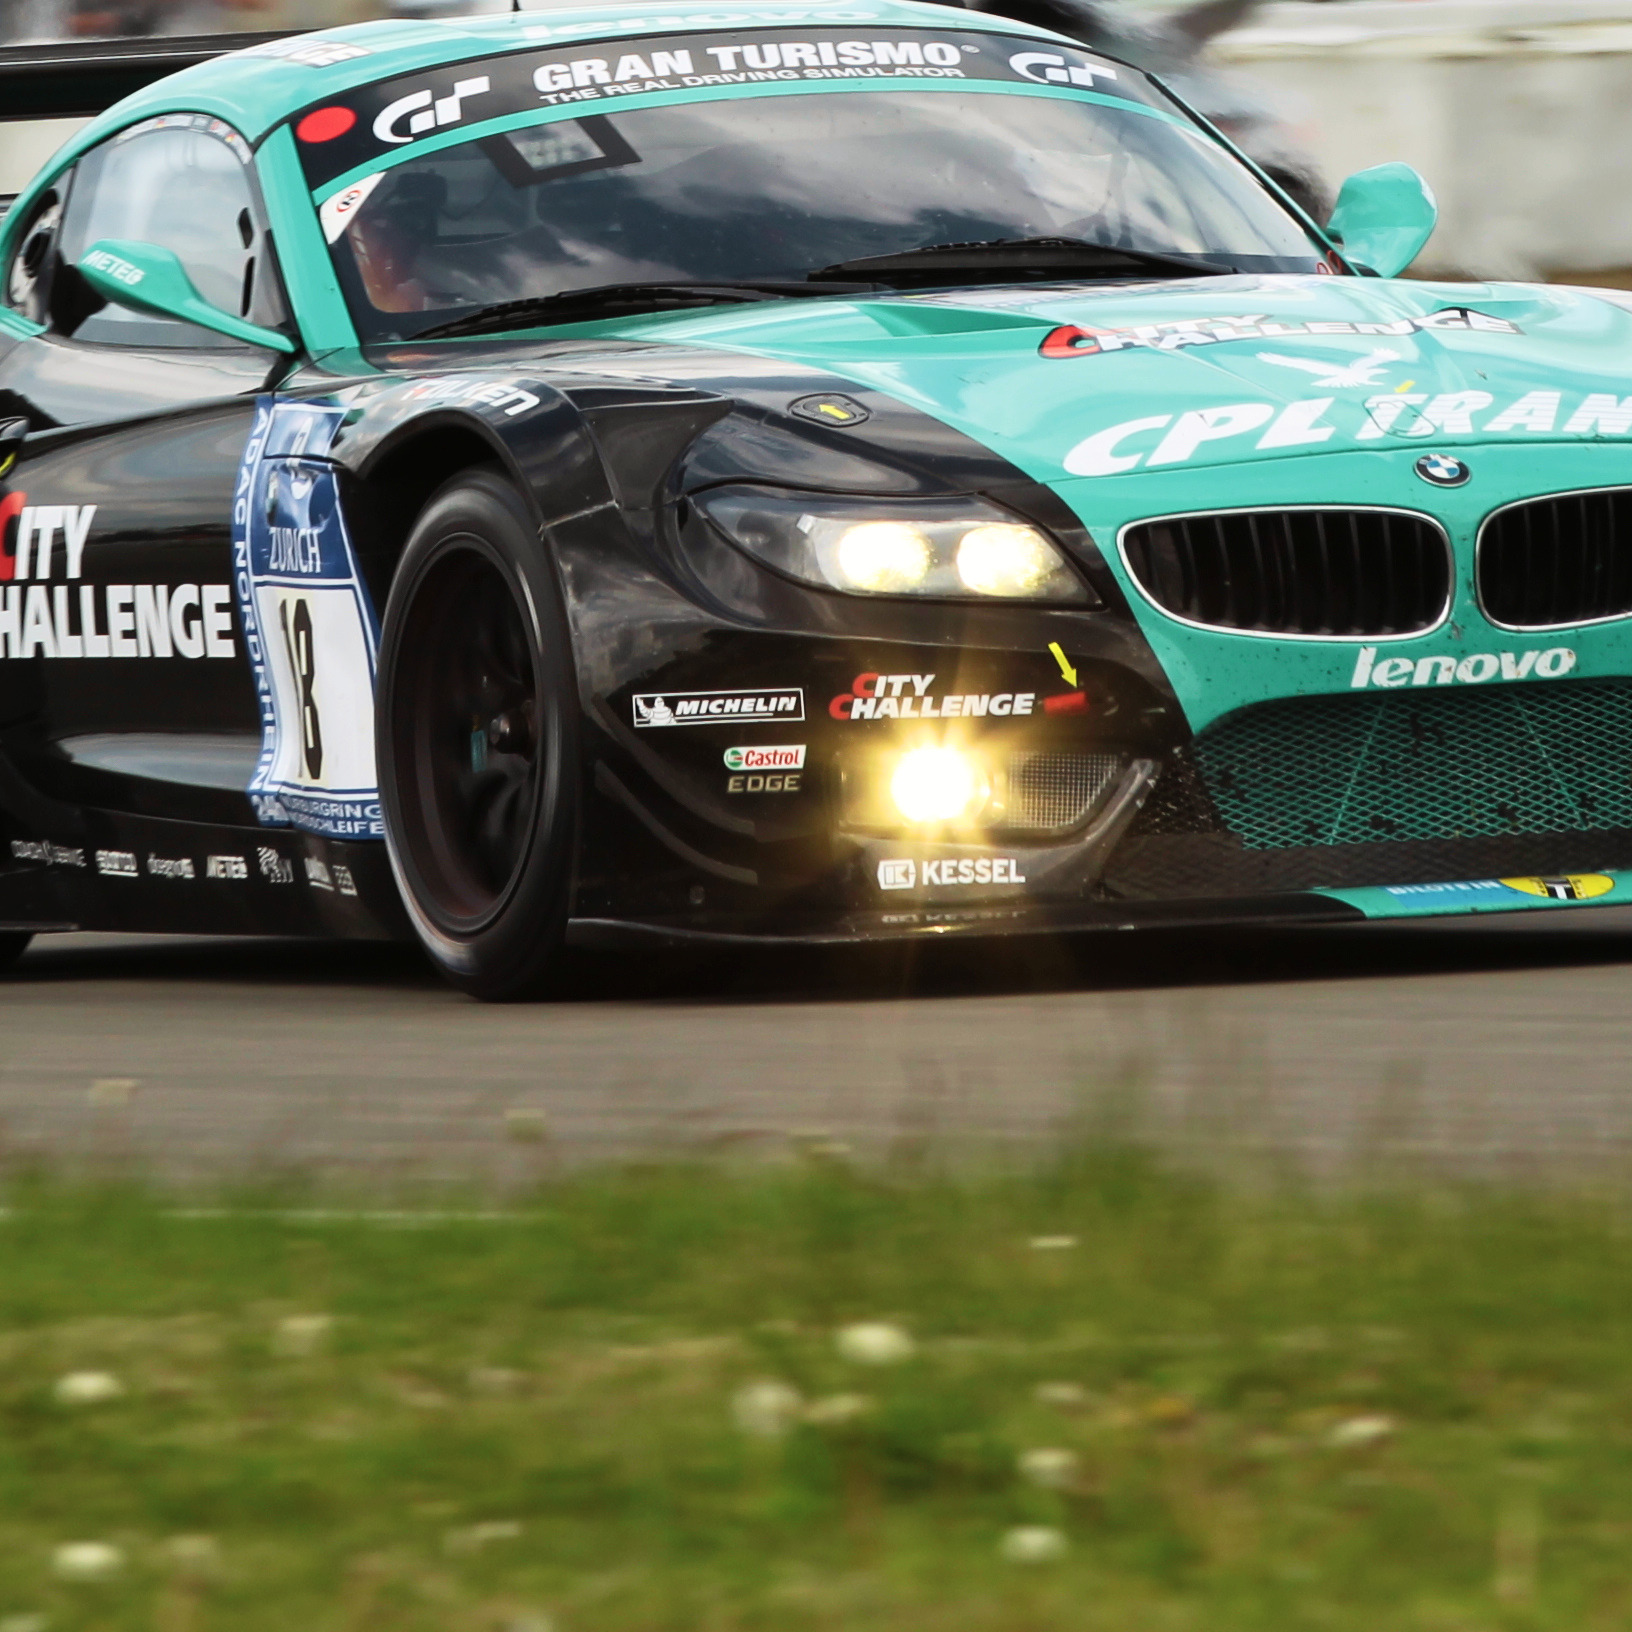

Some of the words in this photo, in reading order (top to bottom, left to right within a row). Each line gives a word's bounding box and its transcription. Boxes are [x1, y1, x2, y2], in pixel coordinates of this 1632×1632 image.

[521, 10, 878, 40] lenovo
[532, 49, 695, 93] GRAN
[706, 40, 962, 72] TURISMO
[540, 87, 601, 106] THE
[604, 78, 681, 97] REAL
[682, 69, 800, 88] DRIVING
[802, 66, 966, 79] SIMULATOR
[1038, 306, 1525, 359] CHALLENGE
[234, 407, 268, 525] ADAC
[1350, 646, 1576, 688] lenovo
[853, 672, 935, 698] CITY
[675, 696, 797, 717] MICHELIN
[828, 692, 1035, 720] CHALLENGE
[744, 747, 800, 767] Castrol
[728, 774, 801, 794] EDGE
[921, 858, 1026, 885] KESSEL
